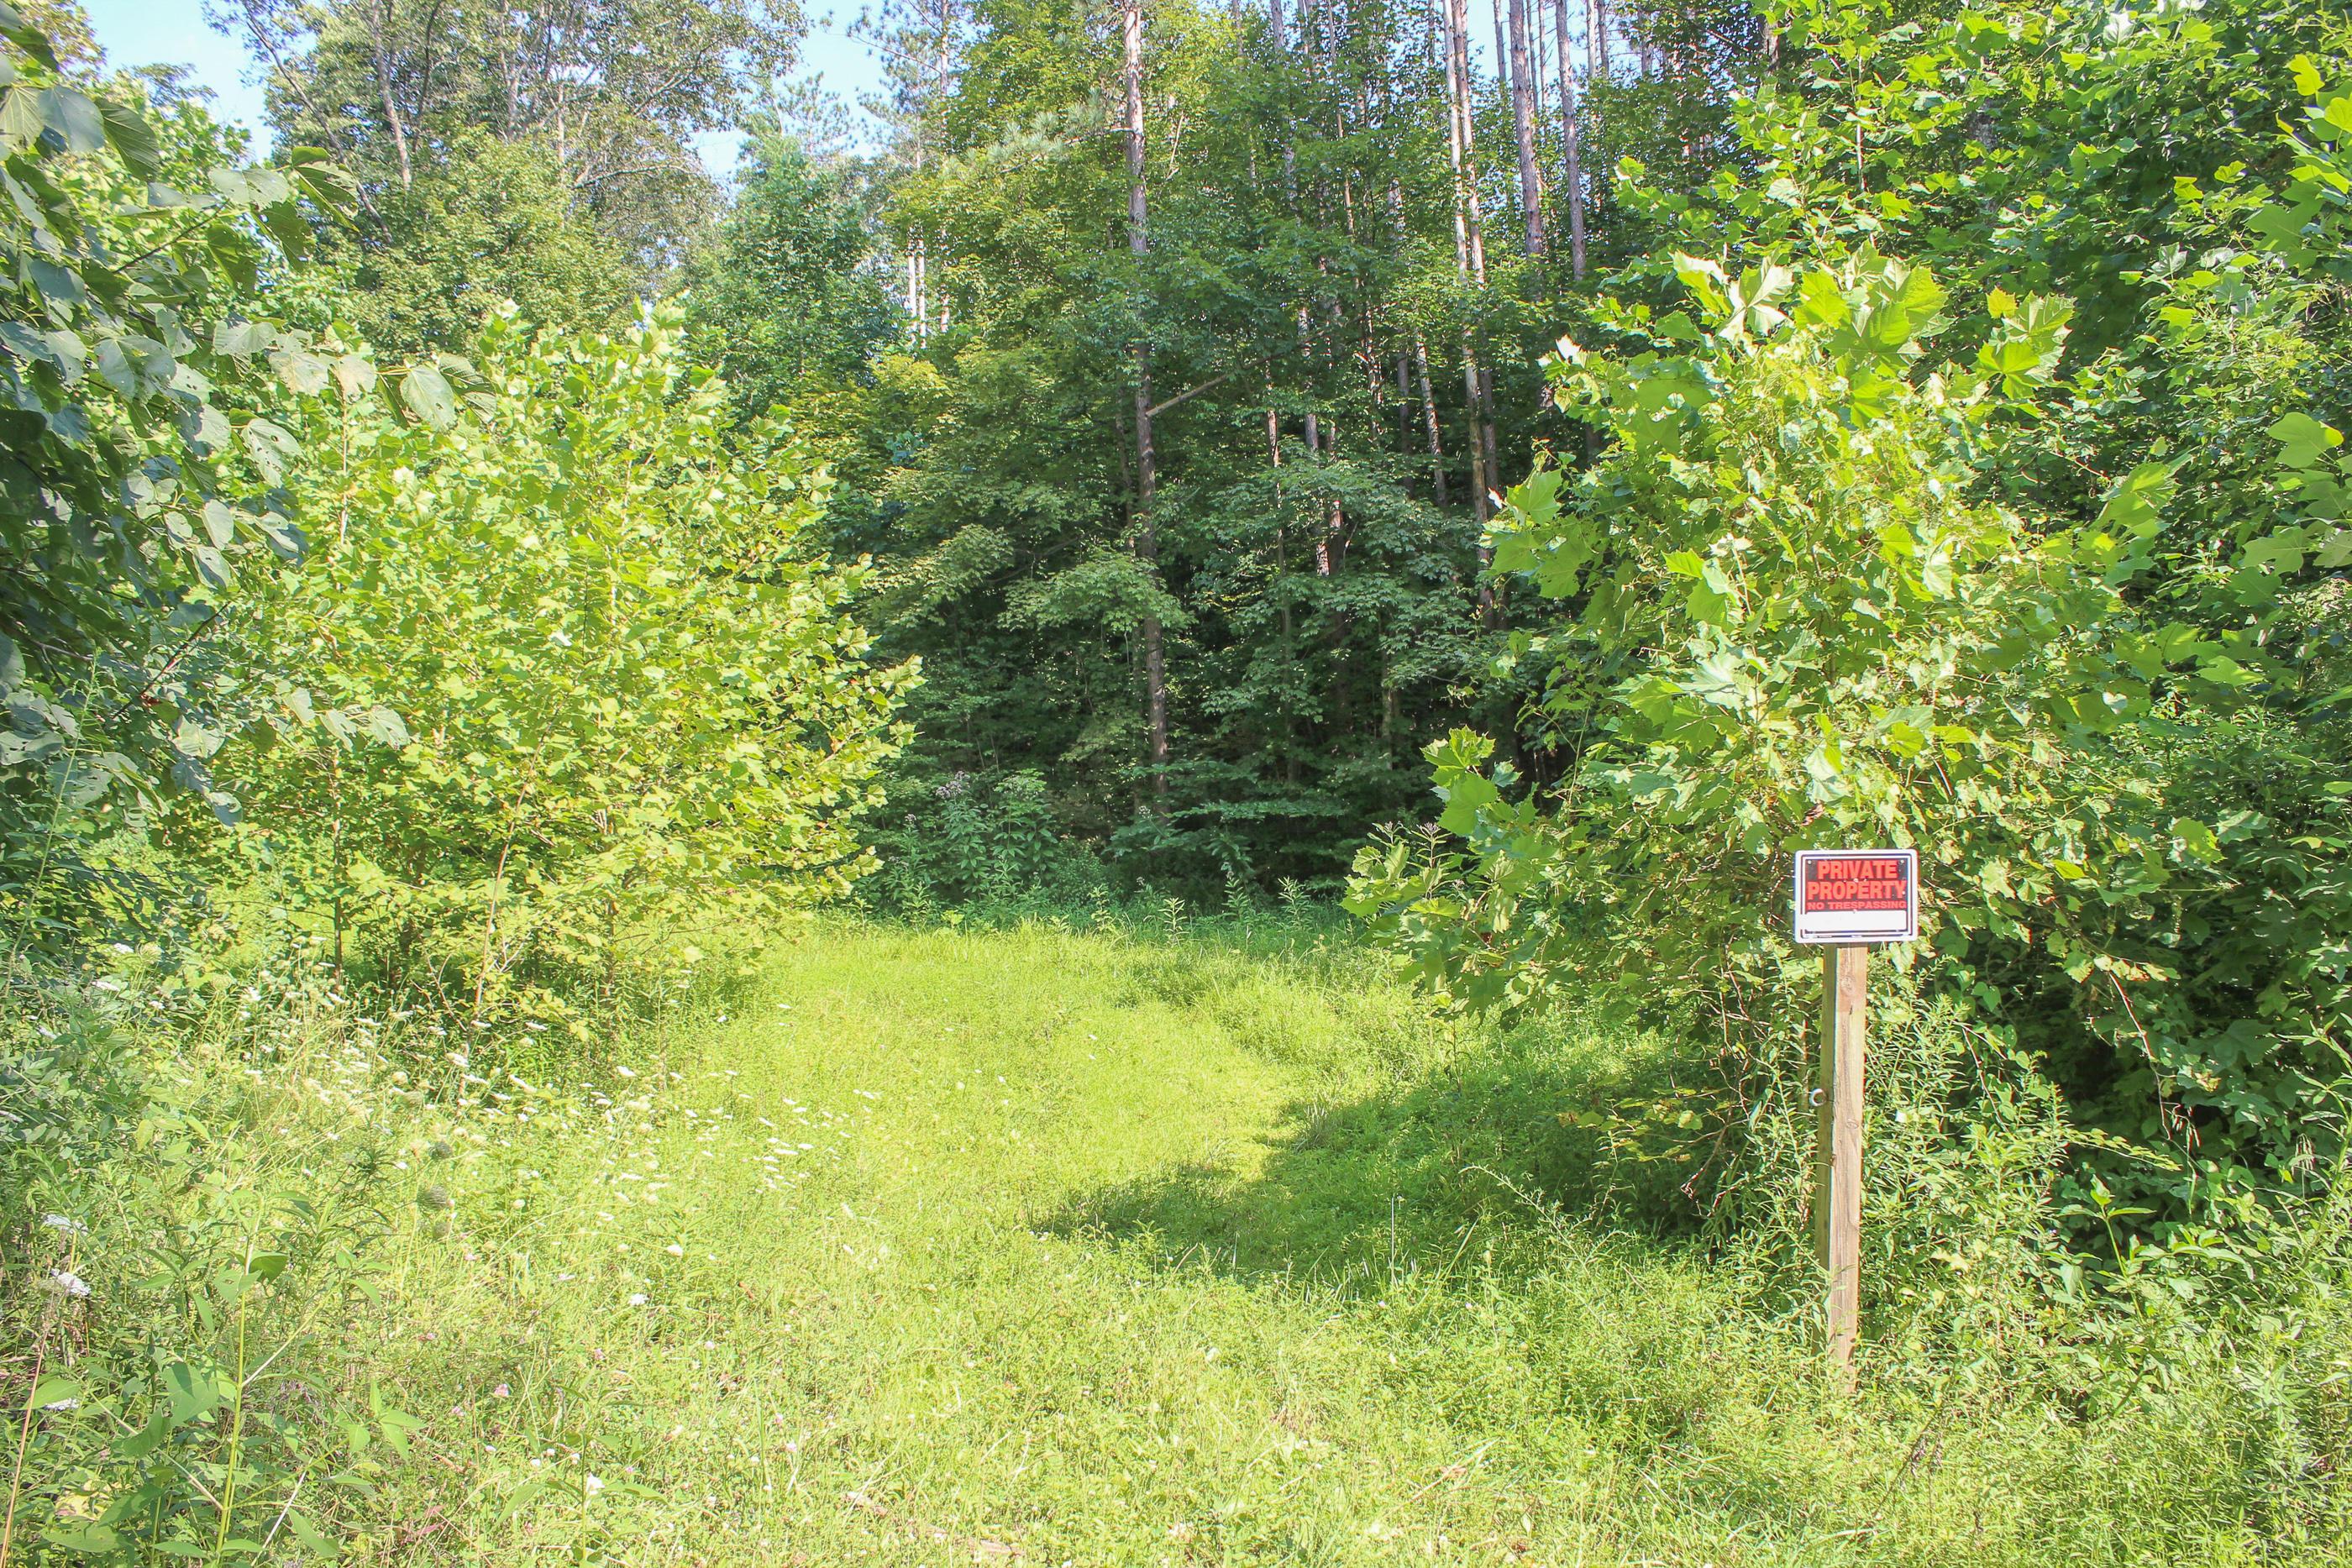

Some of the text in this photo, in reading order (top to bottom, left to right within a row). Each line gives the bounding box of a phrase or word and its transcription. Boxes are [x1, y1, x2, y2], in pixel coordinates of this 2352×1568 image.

[1817, 860, 1898, 879] PRIVATE
[1807, 880, 1907, 900] PROPERTY
[1807, 900, 1907, 910] NO TRESPASSING
